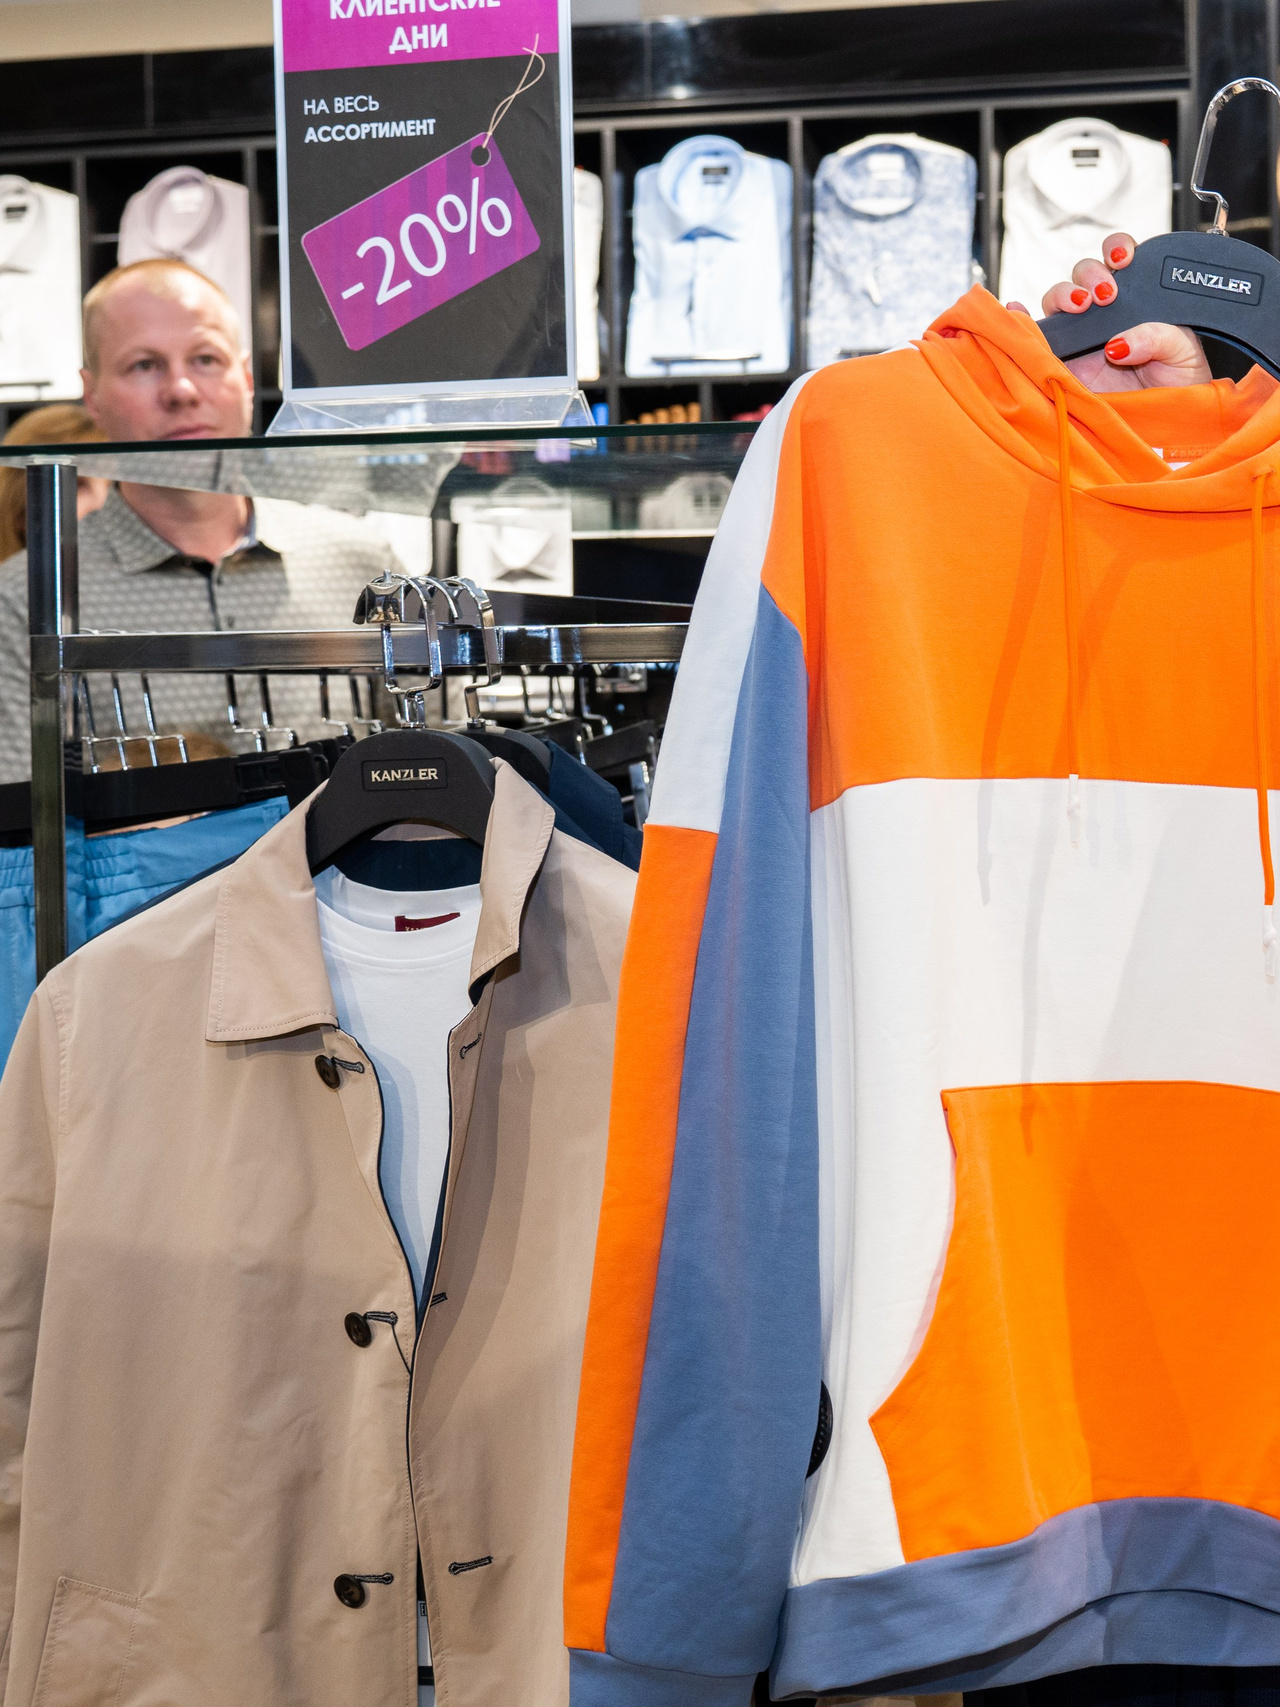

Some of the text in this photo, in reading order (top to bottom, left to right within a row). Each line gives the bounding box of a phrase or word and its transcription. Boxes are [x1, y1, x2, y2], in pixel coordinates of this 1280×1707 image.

[330, 0, 500, 19] КЛИЕНТС
[389, 23, 448, 54] ДНИ
[304, 95, 380, 115] НА ВЕСЬ
[304, 119, 436, 143] АССОРТИМЕНТ
[341, 177, 513, 306] -20%
[1171, 267, 1252, 295] KANZLER
[371, 768, 439, 782] KANZLER
